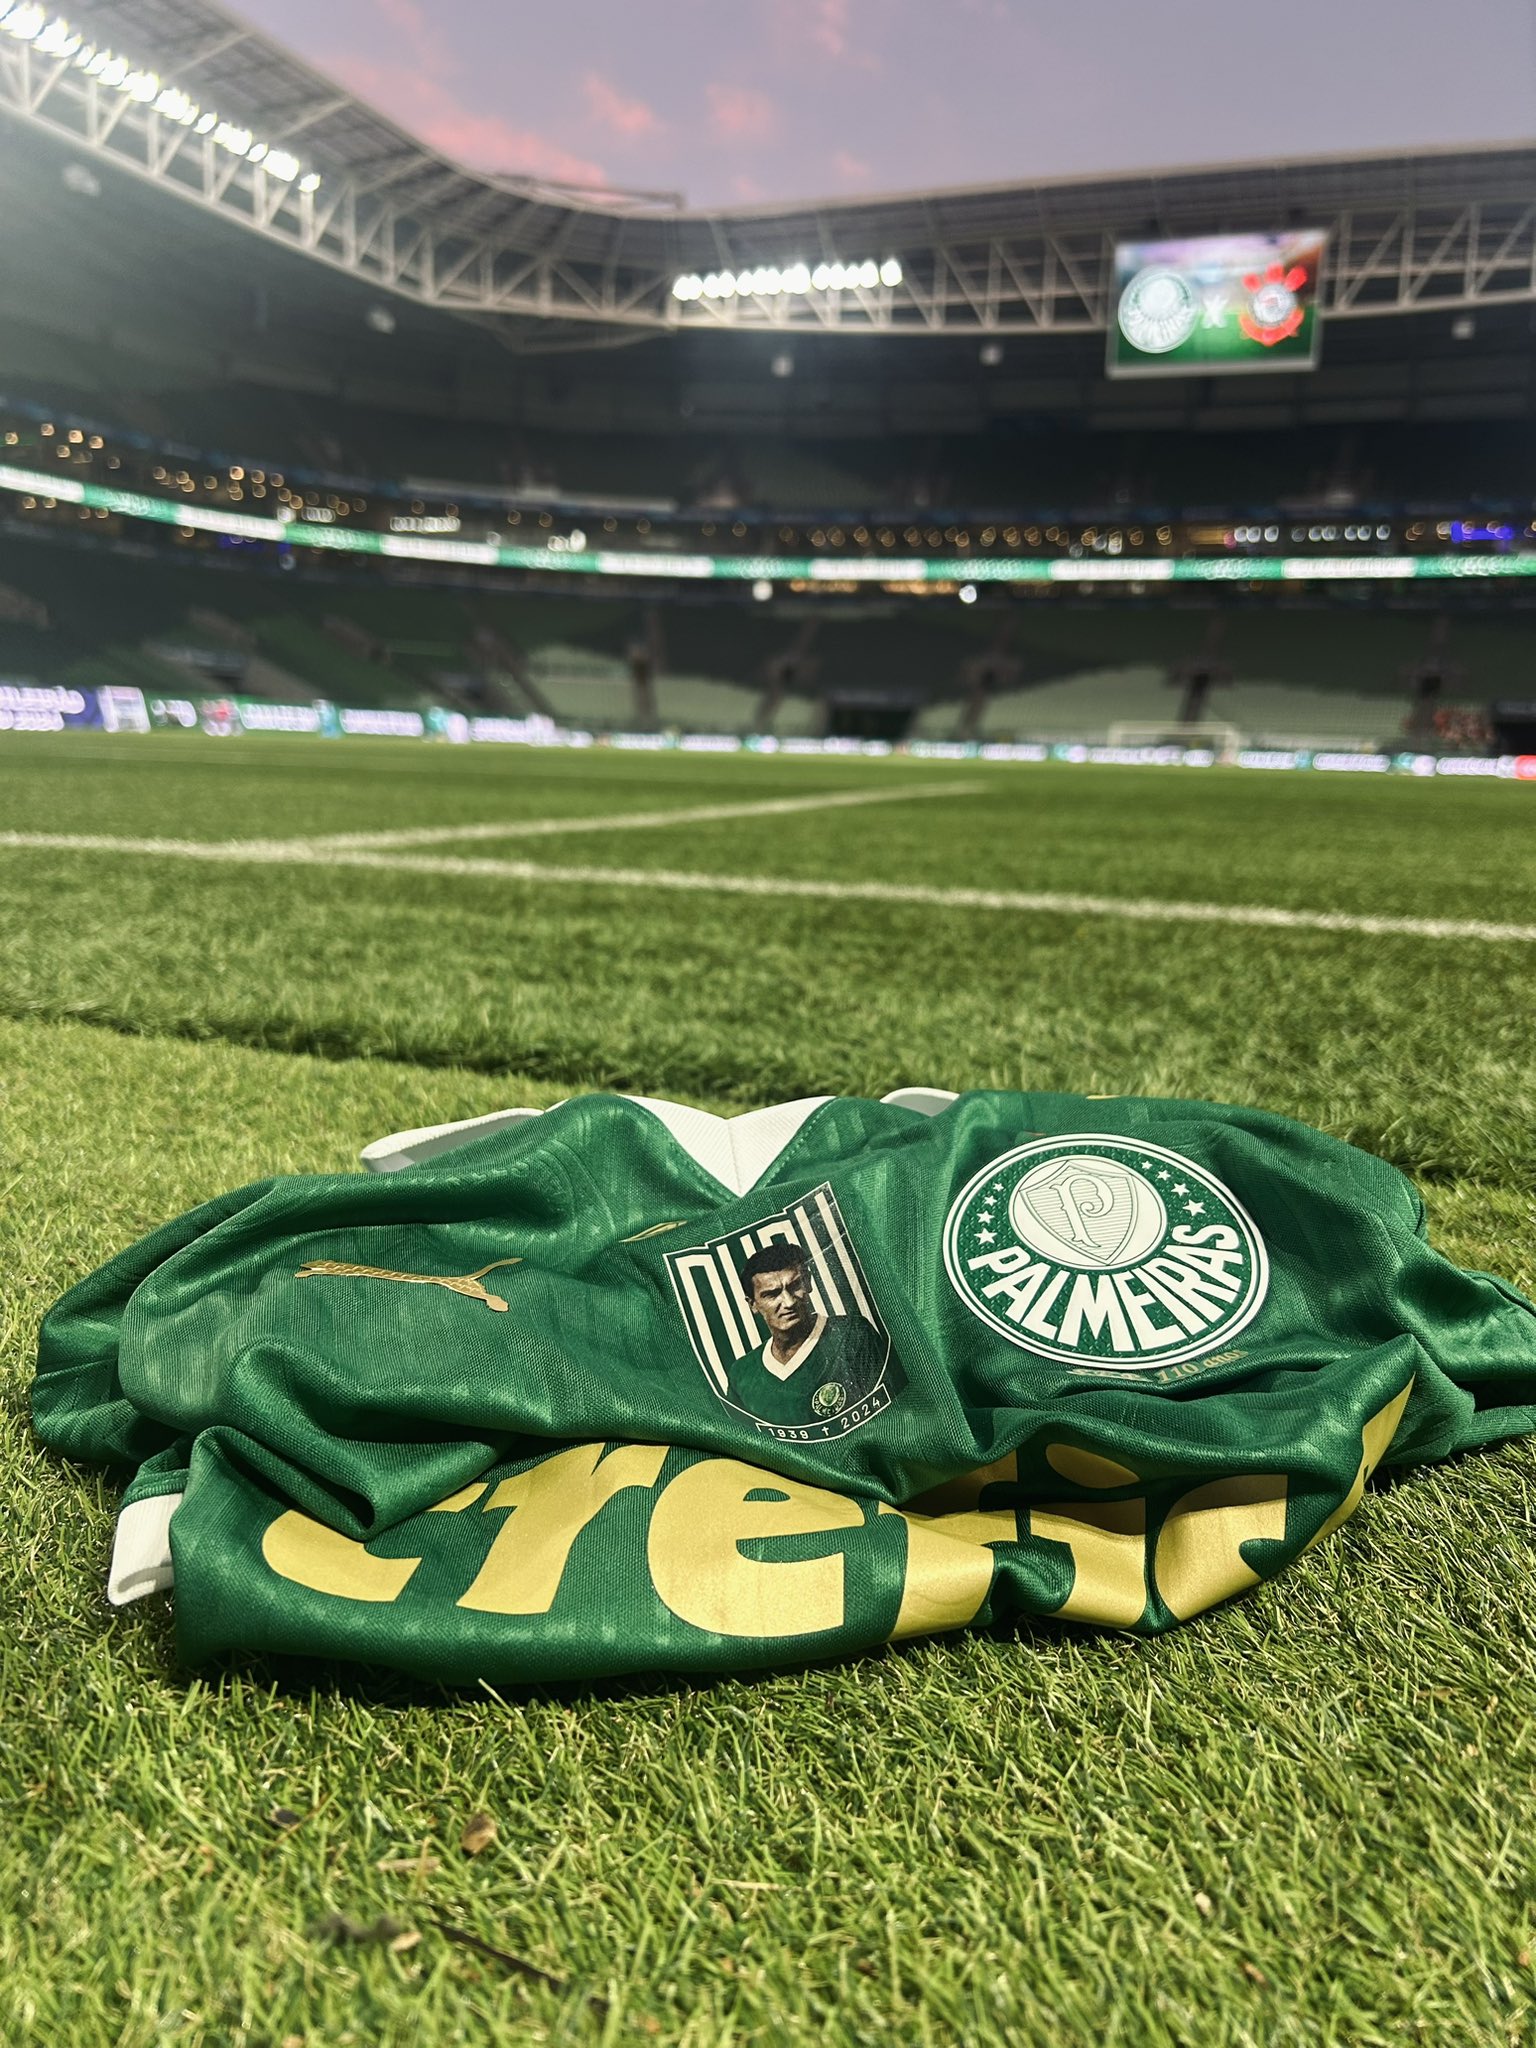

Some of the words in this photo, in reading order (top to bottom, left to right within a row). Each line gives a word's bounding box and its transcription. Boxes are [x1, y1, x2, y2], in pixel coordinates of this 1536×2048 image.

[967, 1224, 1244, 1352] PALMEIRAS
[1157, 1363, 1199, 1383] 110
[1203, 1350, 1246, 1368] ano
[768, 1427, 809, 1440] 1939
[840, 1397, 881, 1429] 2024
